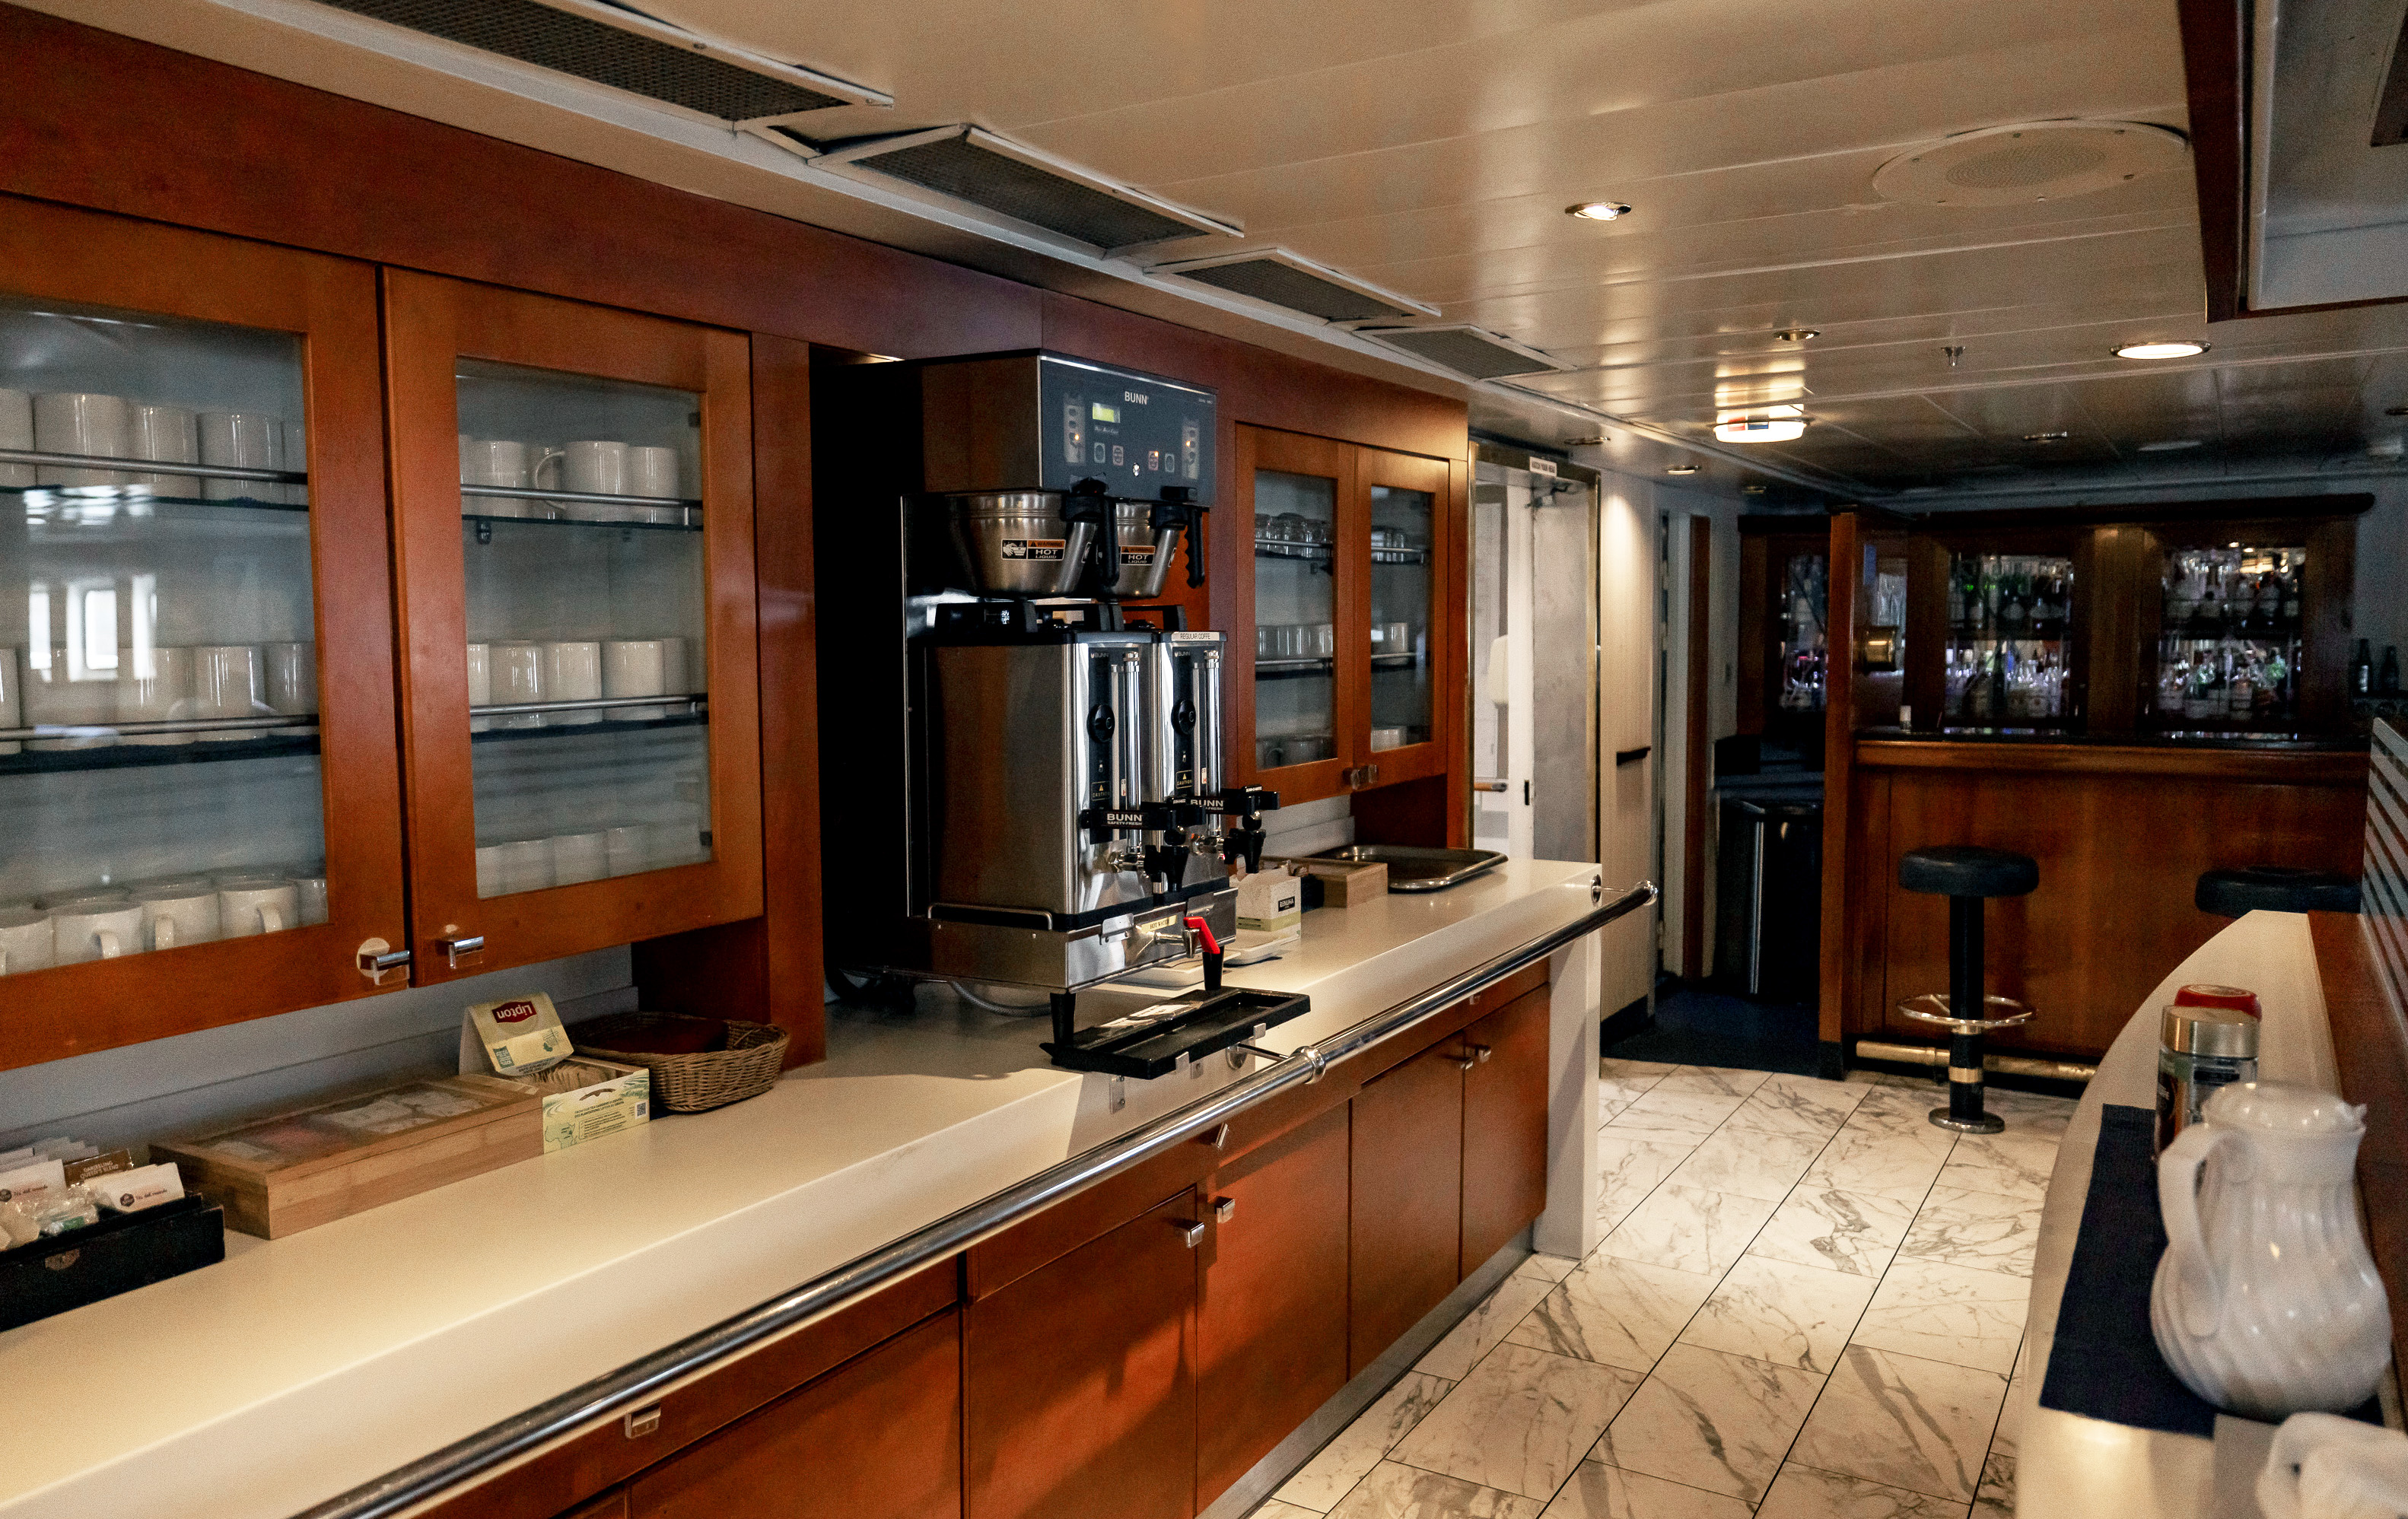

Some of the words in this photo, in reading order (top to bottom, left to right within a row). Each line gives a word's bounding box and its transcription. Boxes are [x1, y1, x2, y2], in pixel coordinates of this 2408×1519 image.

[1124, 391, 1147, 405] BUNN
[1107, 813, 1142, 821] BUNN
[496, 1004, 533, 1019] Lipton
